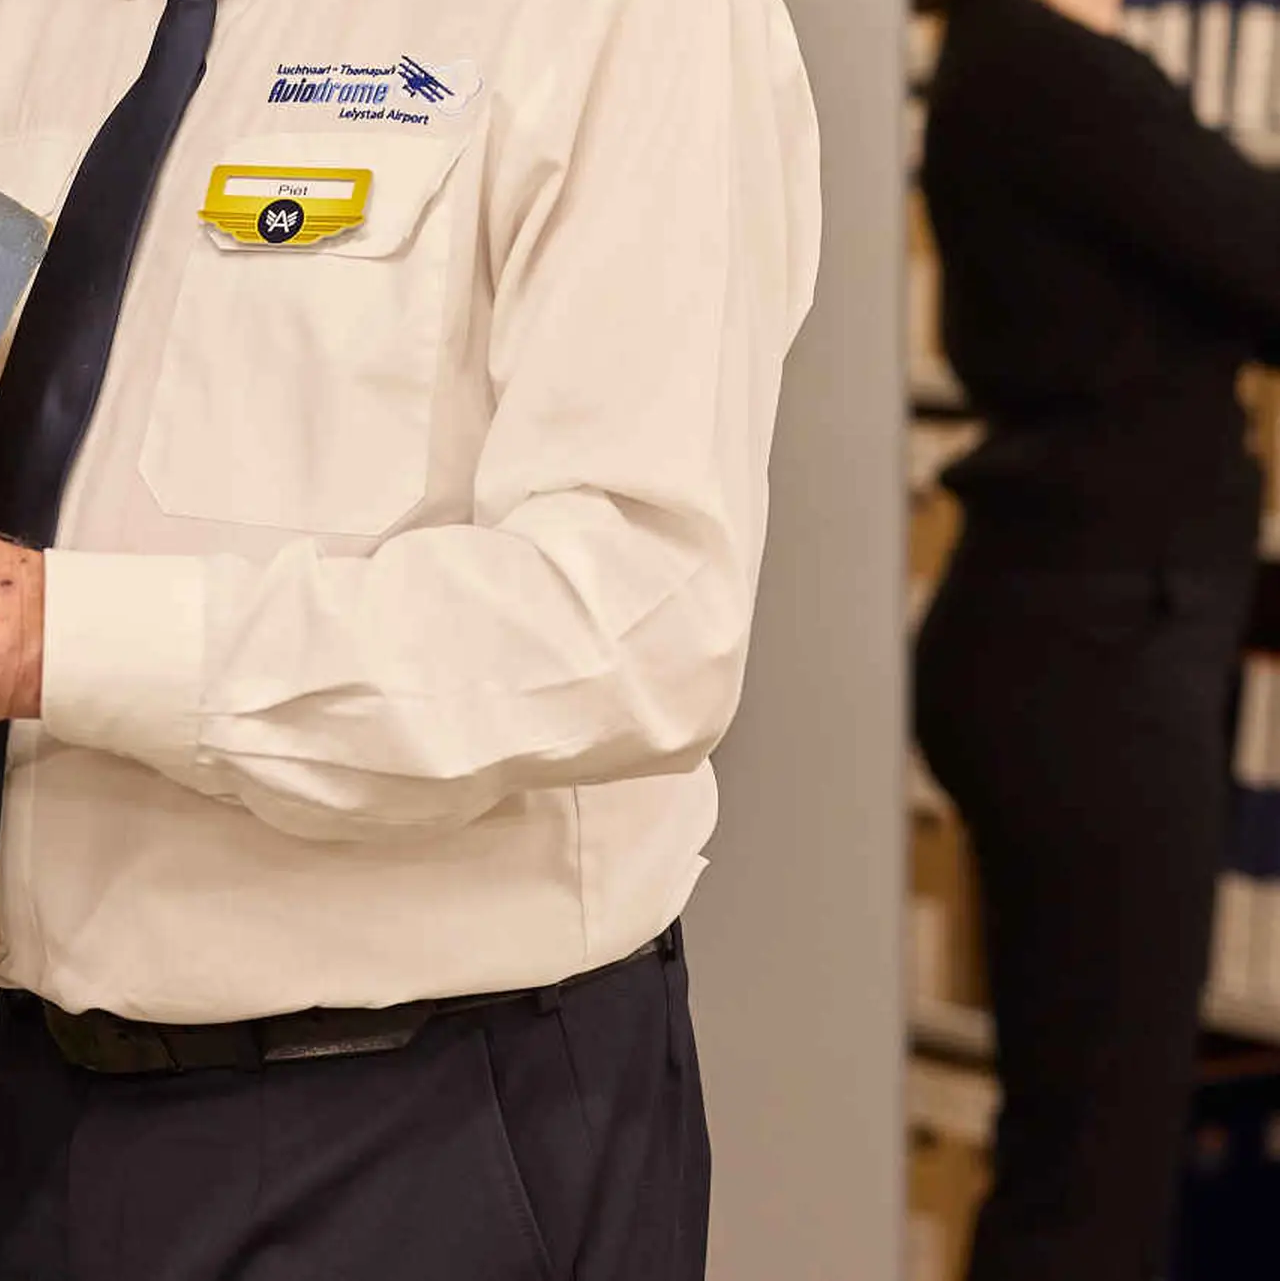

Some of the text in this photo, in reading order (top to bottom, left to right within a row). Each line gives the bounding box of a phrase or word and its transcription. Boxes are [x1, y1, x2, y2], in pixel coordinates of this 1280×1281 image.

[268, 76, 389, 104] Aviodrome
[338, 107, 429, 125] Lelystad Airport
